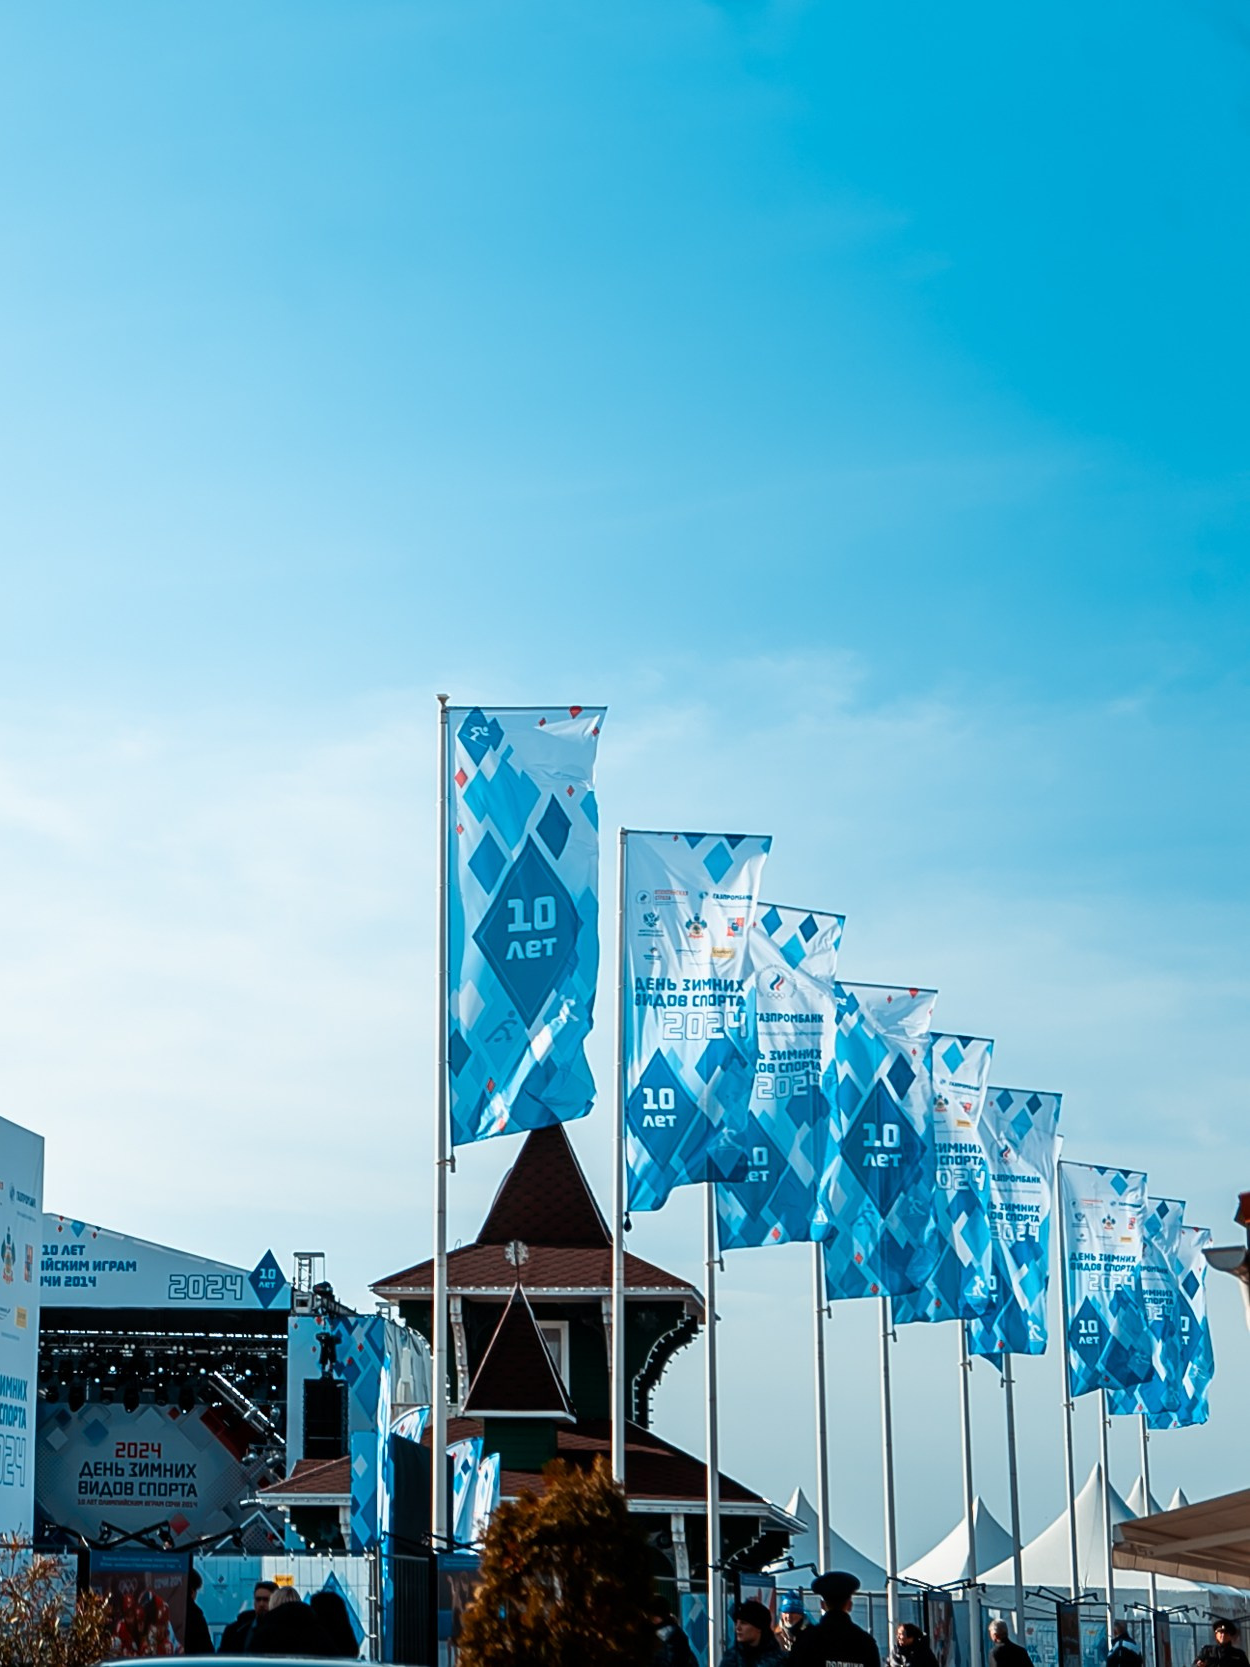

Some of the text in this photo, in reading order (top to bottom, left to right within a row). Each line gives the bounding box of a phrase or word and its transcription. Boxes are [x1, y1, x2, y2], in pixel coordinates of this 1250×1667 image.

[507, 896, 556, 932] 10
[635, 977, 745, 992] ДЕНЬ ЗИМНИХ
[635, 994, 747, 1008] ВИДОВ СПОРТА
[663, 1011, 748, 1040] 2024
[769, 1049, 822, 1060] ЗИМНИХ
[778, 1061, 822, 1073] СПОРТА
[756, 1072, 820, 1100] 2024
[643, 1088, 675, 1110] 10
[862, 1123, 900, 1148] 10
[939, 1155, 985, 1166] СПОРТА
[936, 1168, 985, 1191] 024
[990, 1174, 1041, 1184] АЗПРОМБАНК
[1005, 1212, 1040, 1222] СПОРТА
[42, 1244, 86, 1256] 10 ЛЕТ
[1070, 1252, 1136, 1263] ДЕНЬ ЗИМНИХ
[92, 1260, 137, 1272] ИГРАМ
[1070, 1262, 1135, 1273] ВИДОВ СПОРТА
[64, 1276, 96, 1287] 2014
[258, 1268, 277, 1280] 10
[168, 1274, 243, 1300] 2024
[1088, 1273, 1136, 1292] 2024
[1078, 1319, 1098, 1334] 10
[0, 1403, 27, 1429] СПОРТА
[115, 1442, 161, 1459] 2024
[79, 1461, 197, 1479] ДЕНЬ ЗИМНИХ
[78, 1481, 198, 1497] ВИДОВ СПОРТА
